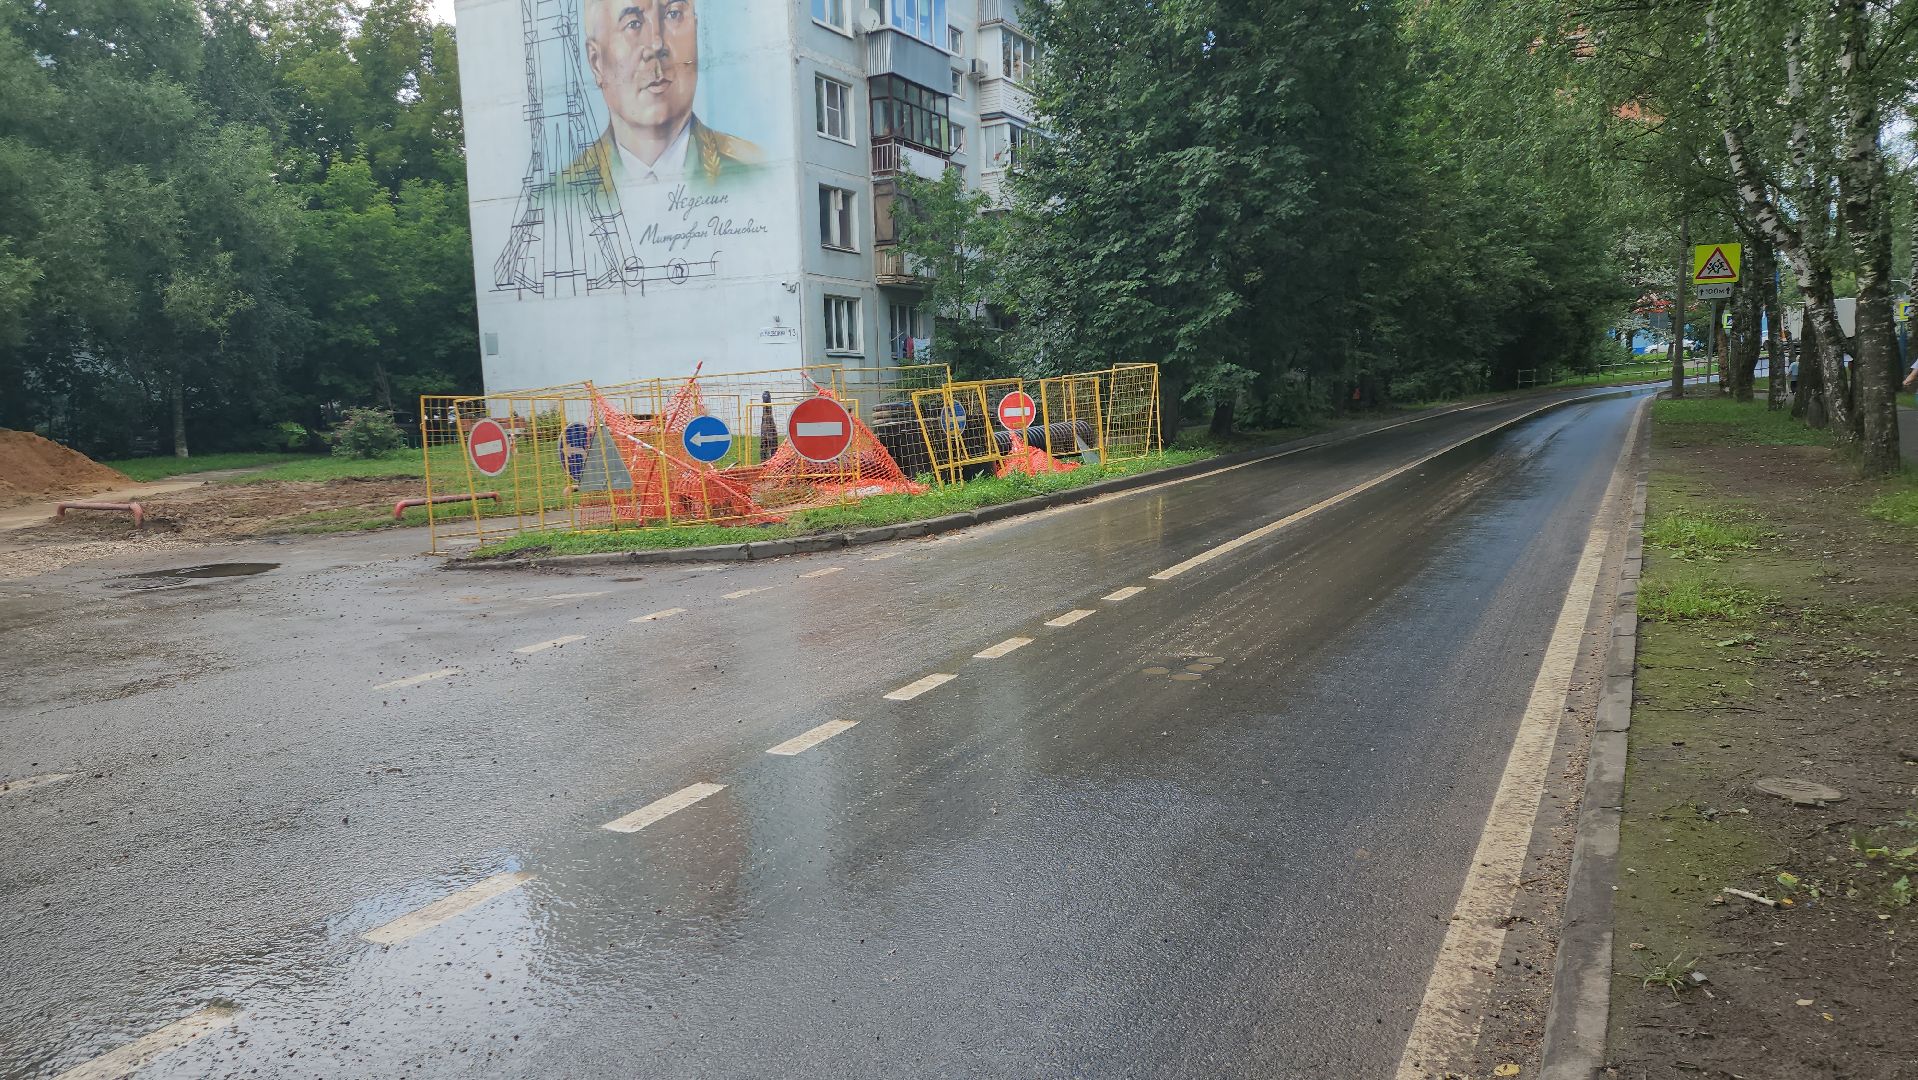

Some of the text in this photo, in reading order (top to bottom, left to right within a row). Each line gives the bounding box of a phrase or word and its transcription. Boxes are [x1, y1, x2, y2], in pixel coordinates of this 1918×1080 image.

[667, 184, 729, 221] Неделин
[640, 216, 768, 252] Митрофан Иванович
